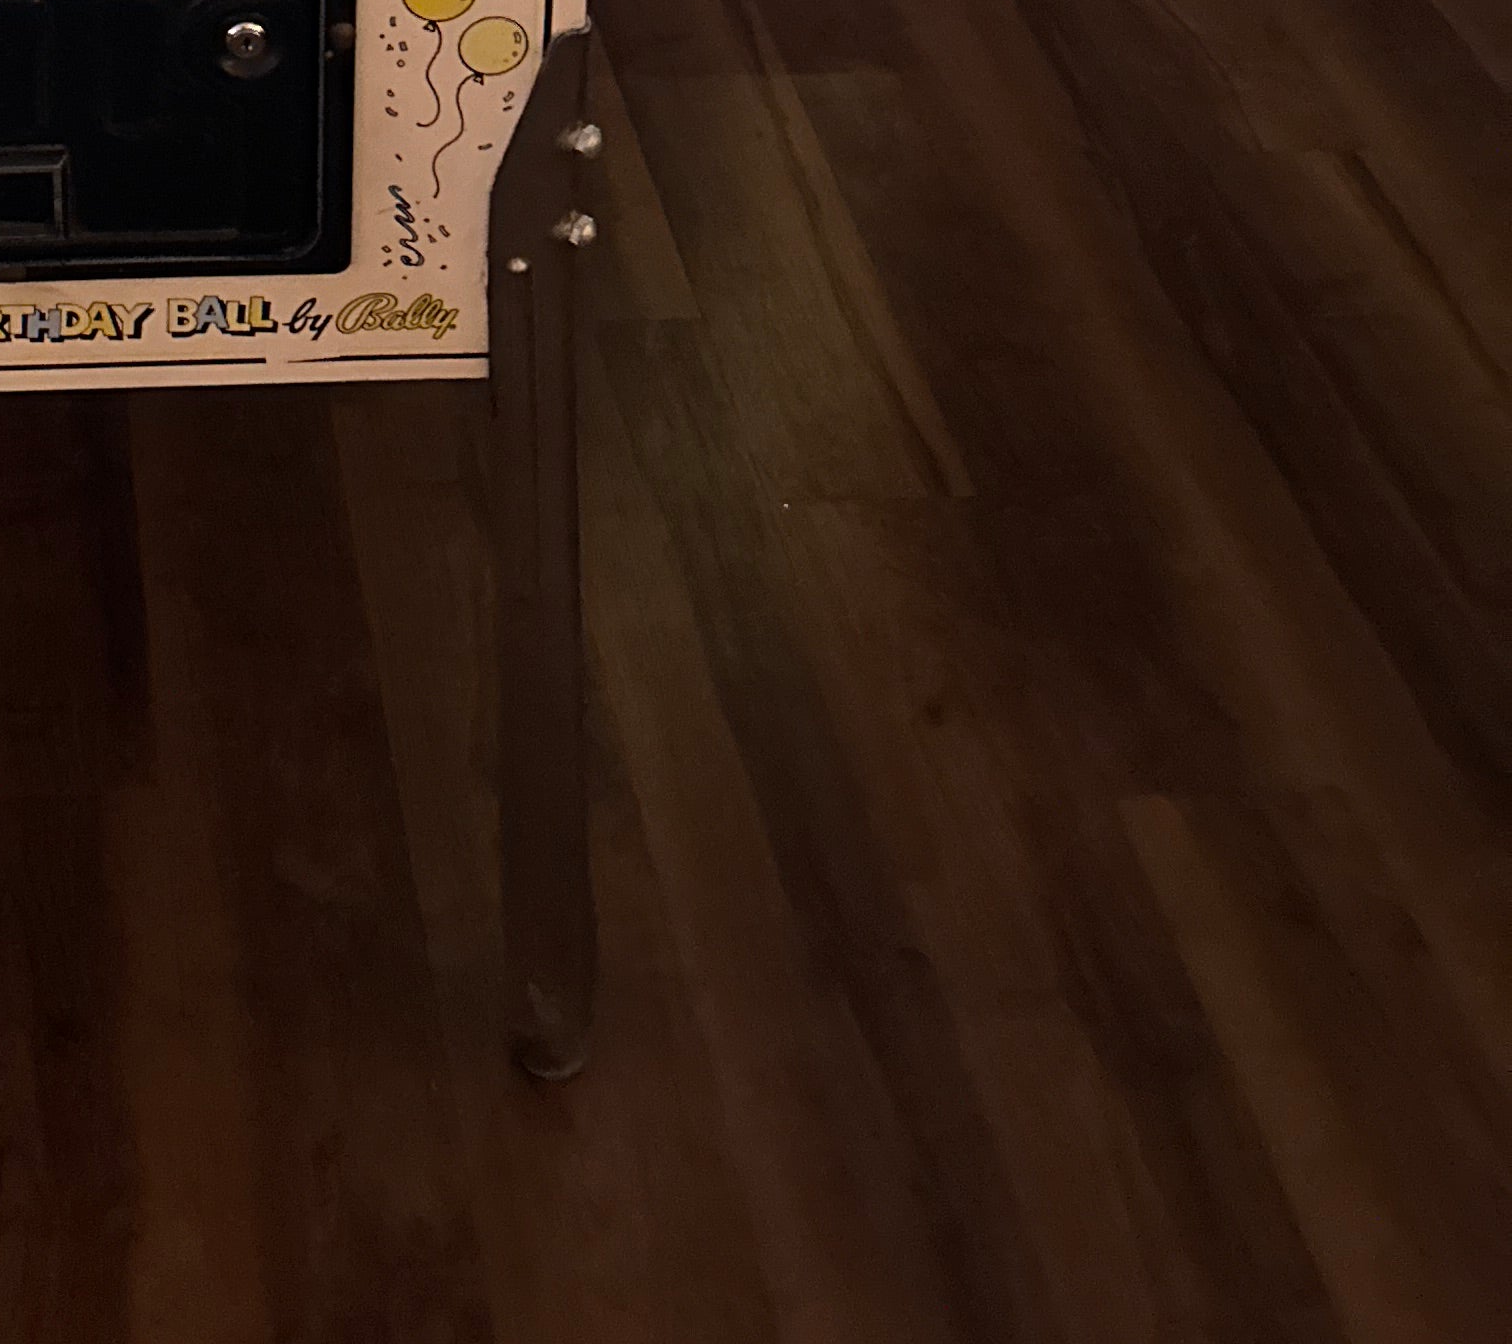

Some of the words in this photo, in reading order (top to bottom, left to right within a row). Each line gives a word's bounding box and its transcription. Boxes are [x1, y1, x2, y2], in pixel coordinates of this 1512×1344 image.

[167, 295, 279, 339] BALL
[282, 297, 334, 341] by
[335, 292, 460, 340] Bally
